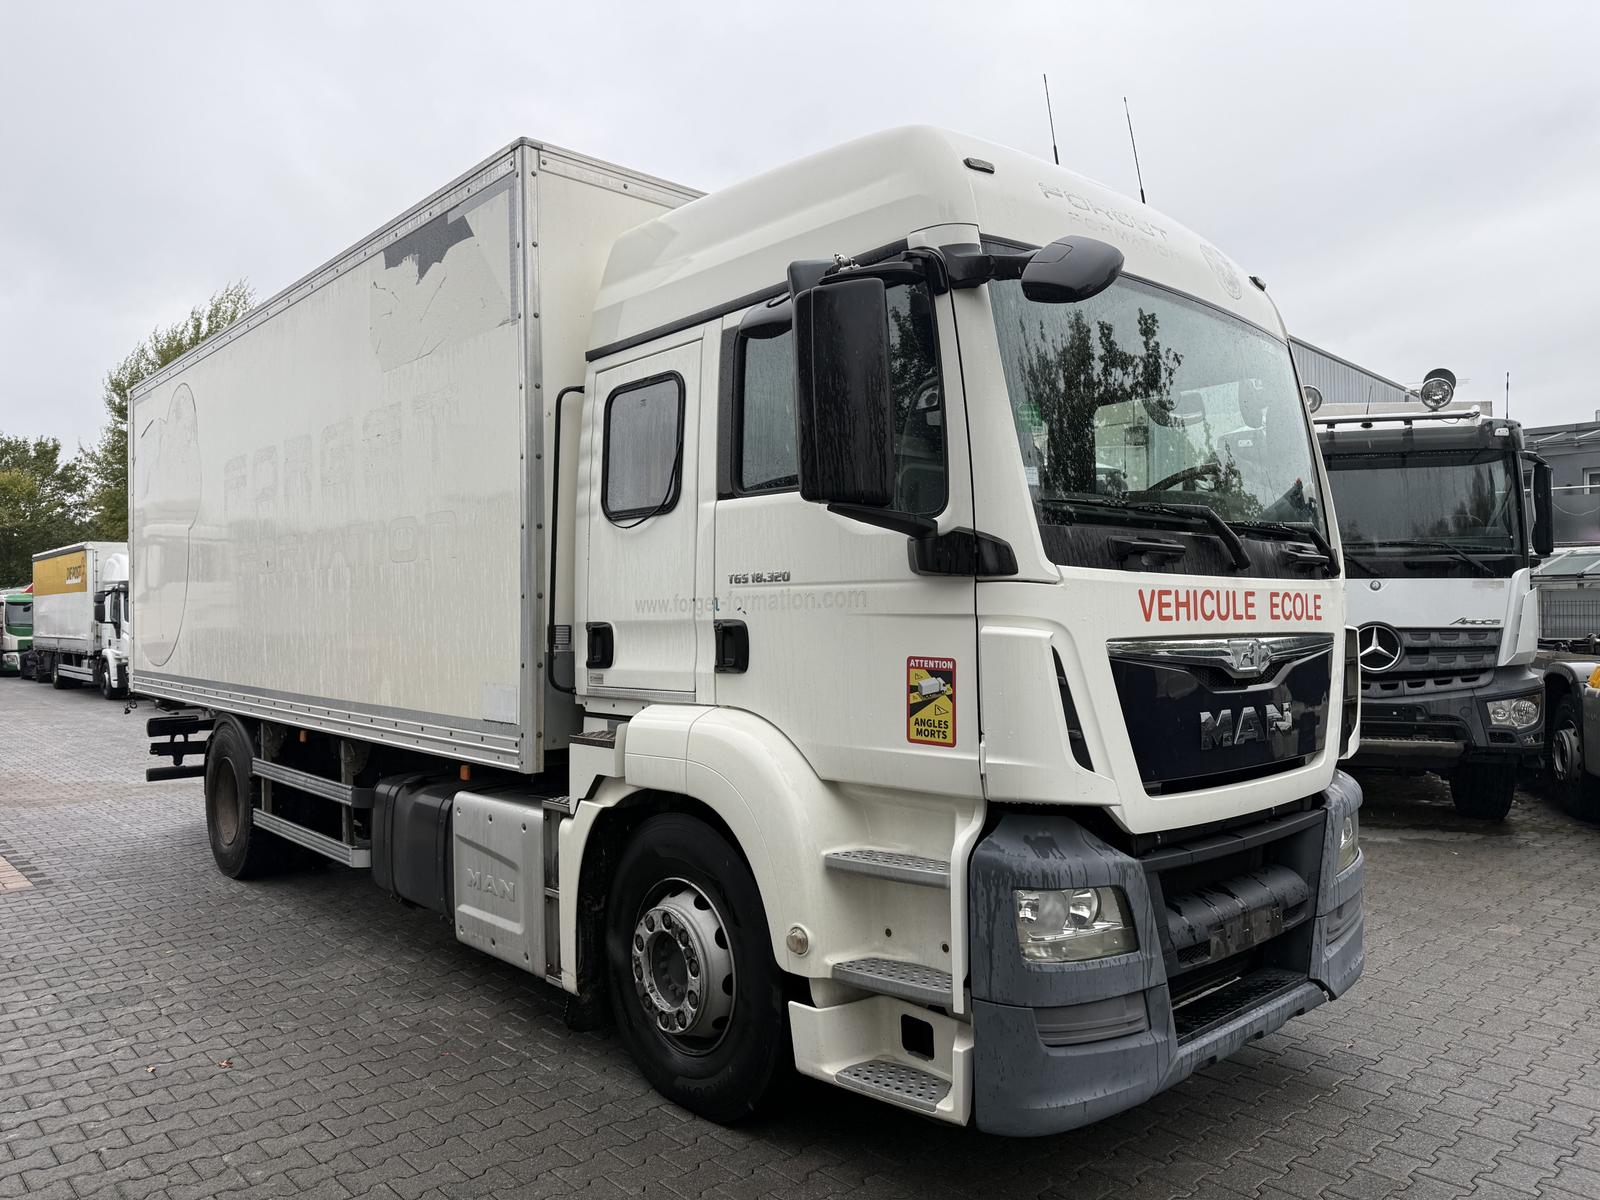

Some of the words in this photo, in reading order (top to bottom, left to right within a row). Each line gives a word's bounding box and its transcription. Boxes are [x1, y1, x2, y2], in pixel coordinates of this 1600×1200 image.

[728, 573, 749, 584] TGS
[751, 571, 791, 583] 18.320
[1138, 589, 1257, 622] VEHICULE
[1269, 591, 1322, 621] ECOLE
[909, 659, 953, 670] ATTENTION
[914, 717, 949, 729] ANGLES
[1200, 702, 1293, 751] MAN
[916, 727, 947, 740] MORTS
[467, 867, 515, 903] MAN
